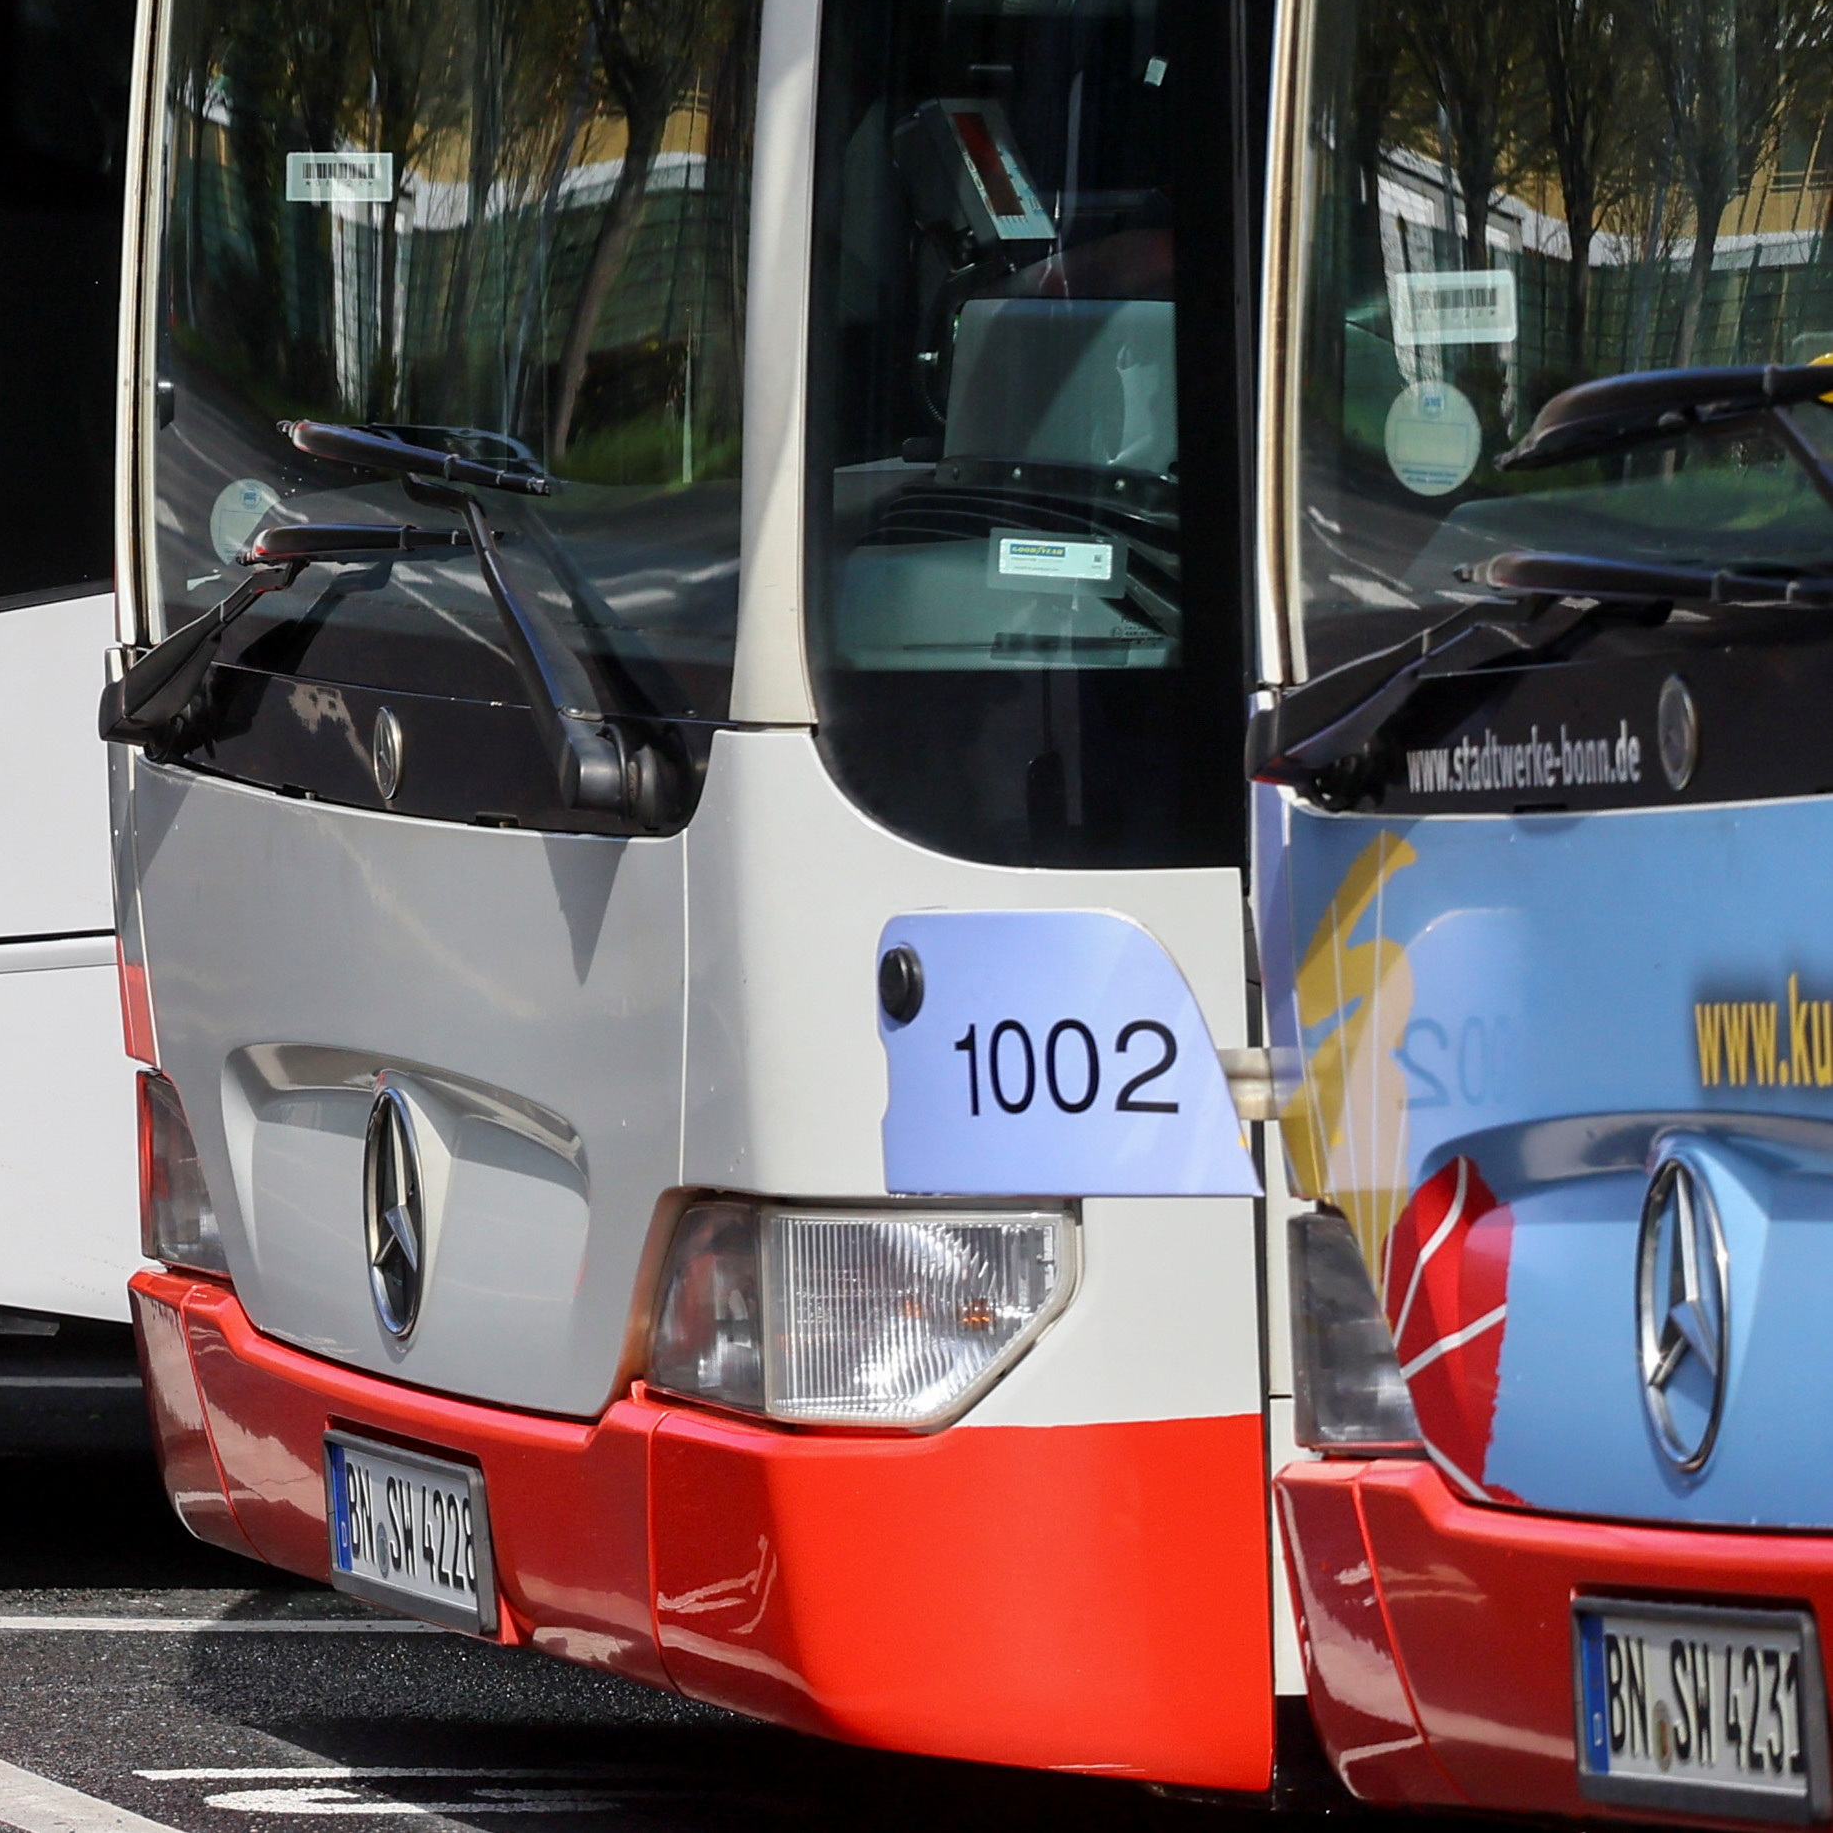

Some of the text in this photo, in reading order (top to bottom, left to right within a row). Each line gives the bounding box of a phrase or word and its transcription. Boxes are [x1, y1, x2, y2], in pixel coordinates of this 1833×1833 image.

[1011, 544, 1065, 556] GOODYEAR
[1407, 719, 1641, 793] www.stadtwerke-bonn.de
[953, 1018, 1179, 1117] 1002
[1694, 971, 1833, 1088] www.ku
[346, 1462, 377, 1565] BN
[386, 1475, 418, 1578] SW
[421, 1485, 477, 1594] 4228
[1605, 1634, 1650, 1761] BN
[1670, 1639, 1715, 1768] SW
[1726, 1644, 1802, 1775] 4231
